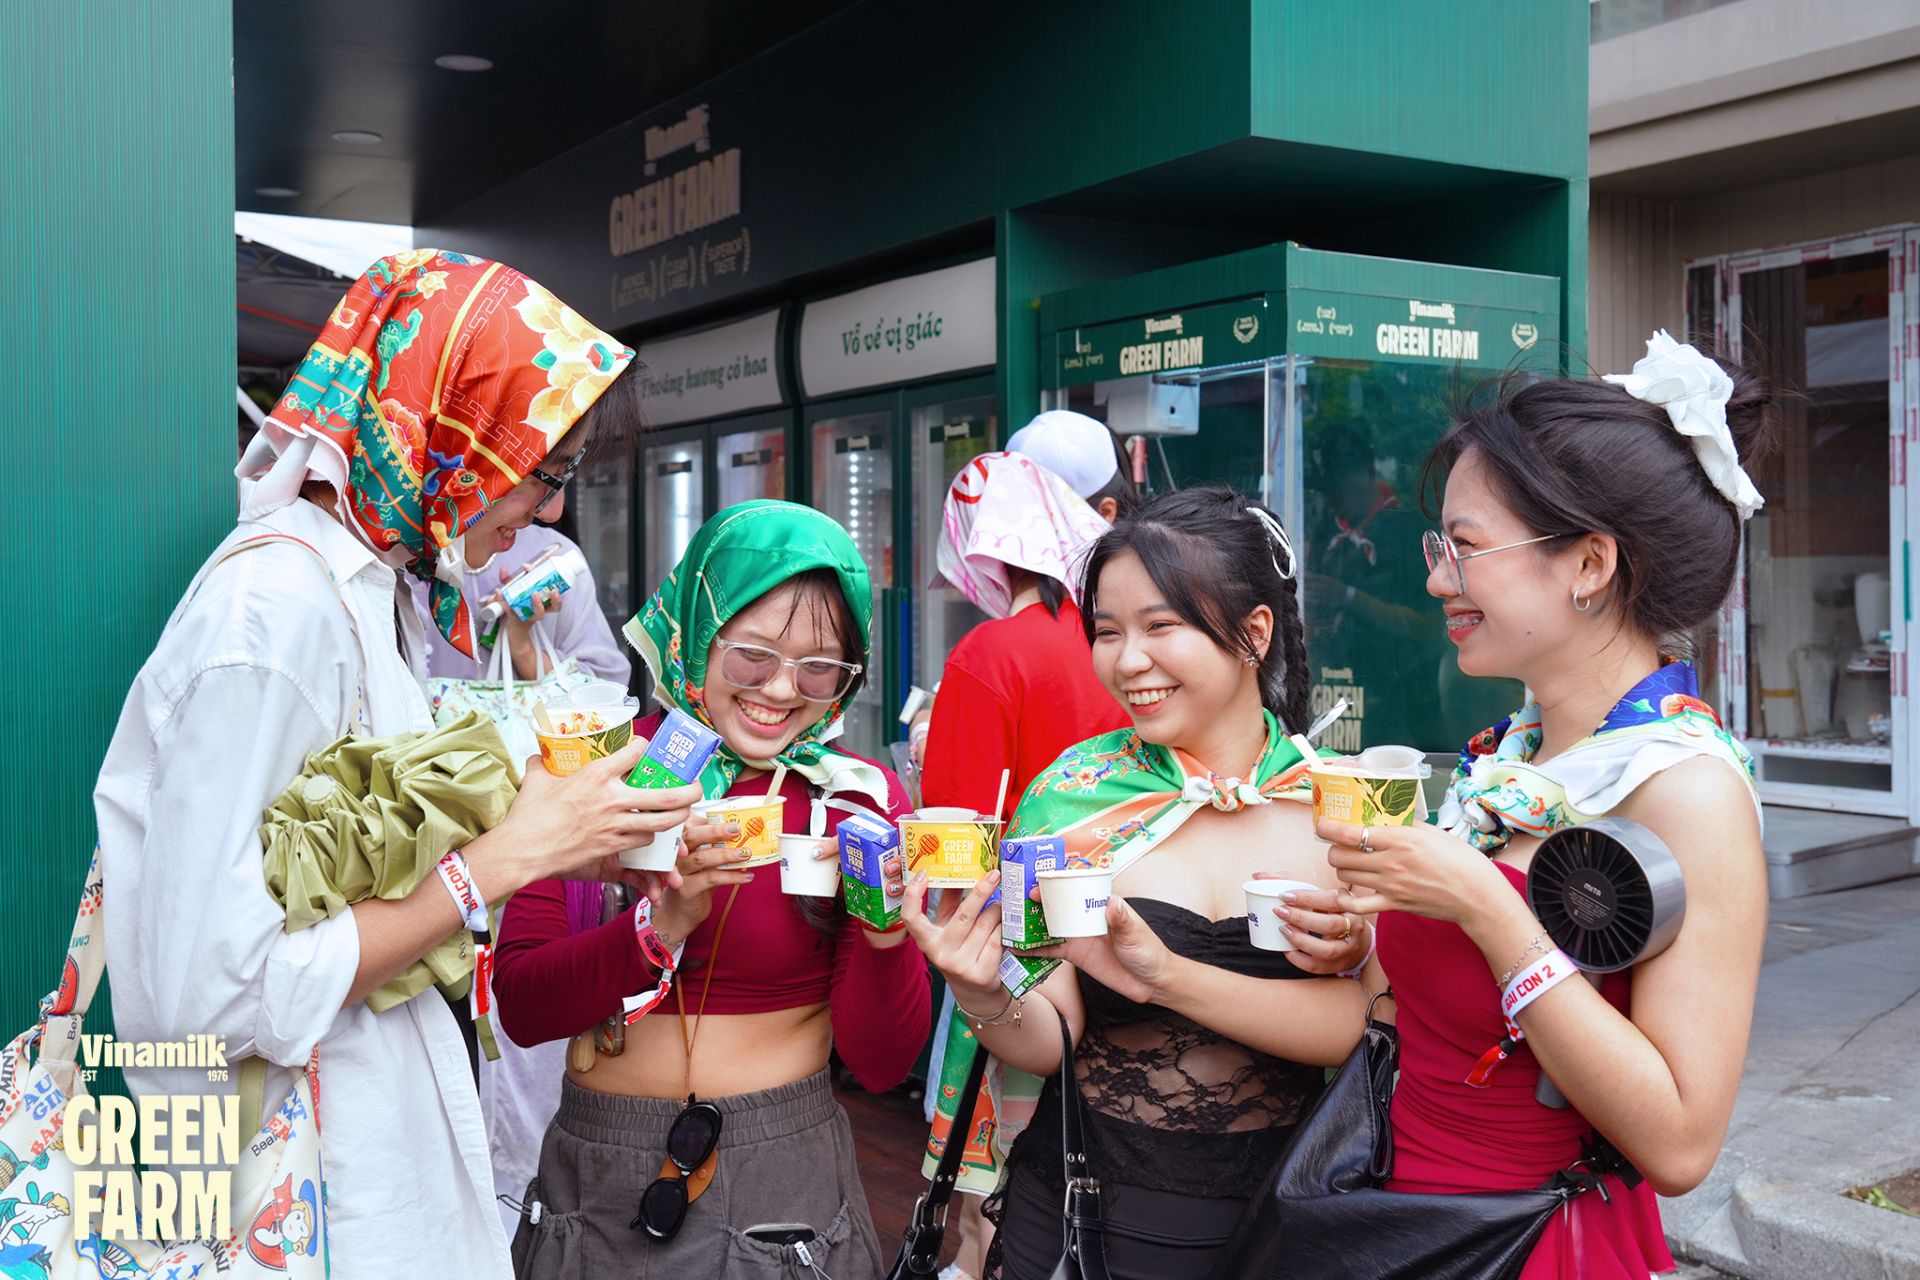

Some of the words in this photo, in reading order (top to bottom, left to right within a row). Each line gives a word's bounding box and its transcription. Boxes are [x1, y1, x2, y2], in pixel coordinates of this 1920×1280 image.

[1409, 300, 1456, 318] Vinamilk
[905, 311, 943, 350] giác
[1376, 323, 1430, 357] GREEN
[1432, 327, 1479, 360] FARM
[1119, 342, 1162, 375] GREEN
[1163, 336, 1203, 370] FARM
[670, 731, 697, 752] GREEN
[1310, 719, 1361, 752] ARM
[665, 740, 690, 761] FARM
[1324, 792, 1352, 808] GREEN
[1326, 805, 1351, 820] FARM
[943, 839, 975, 852] GREEN
[945, 852, 972, 864] FARM
[1035, 857, 1056, 870] GREEN
[1516, 972, 1543, 998] CON
[1542, 964, 1556, 979] 2
